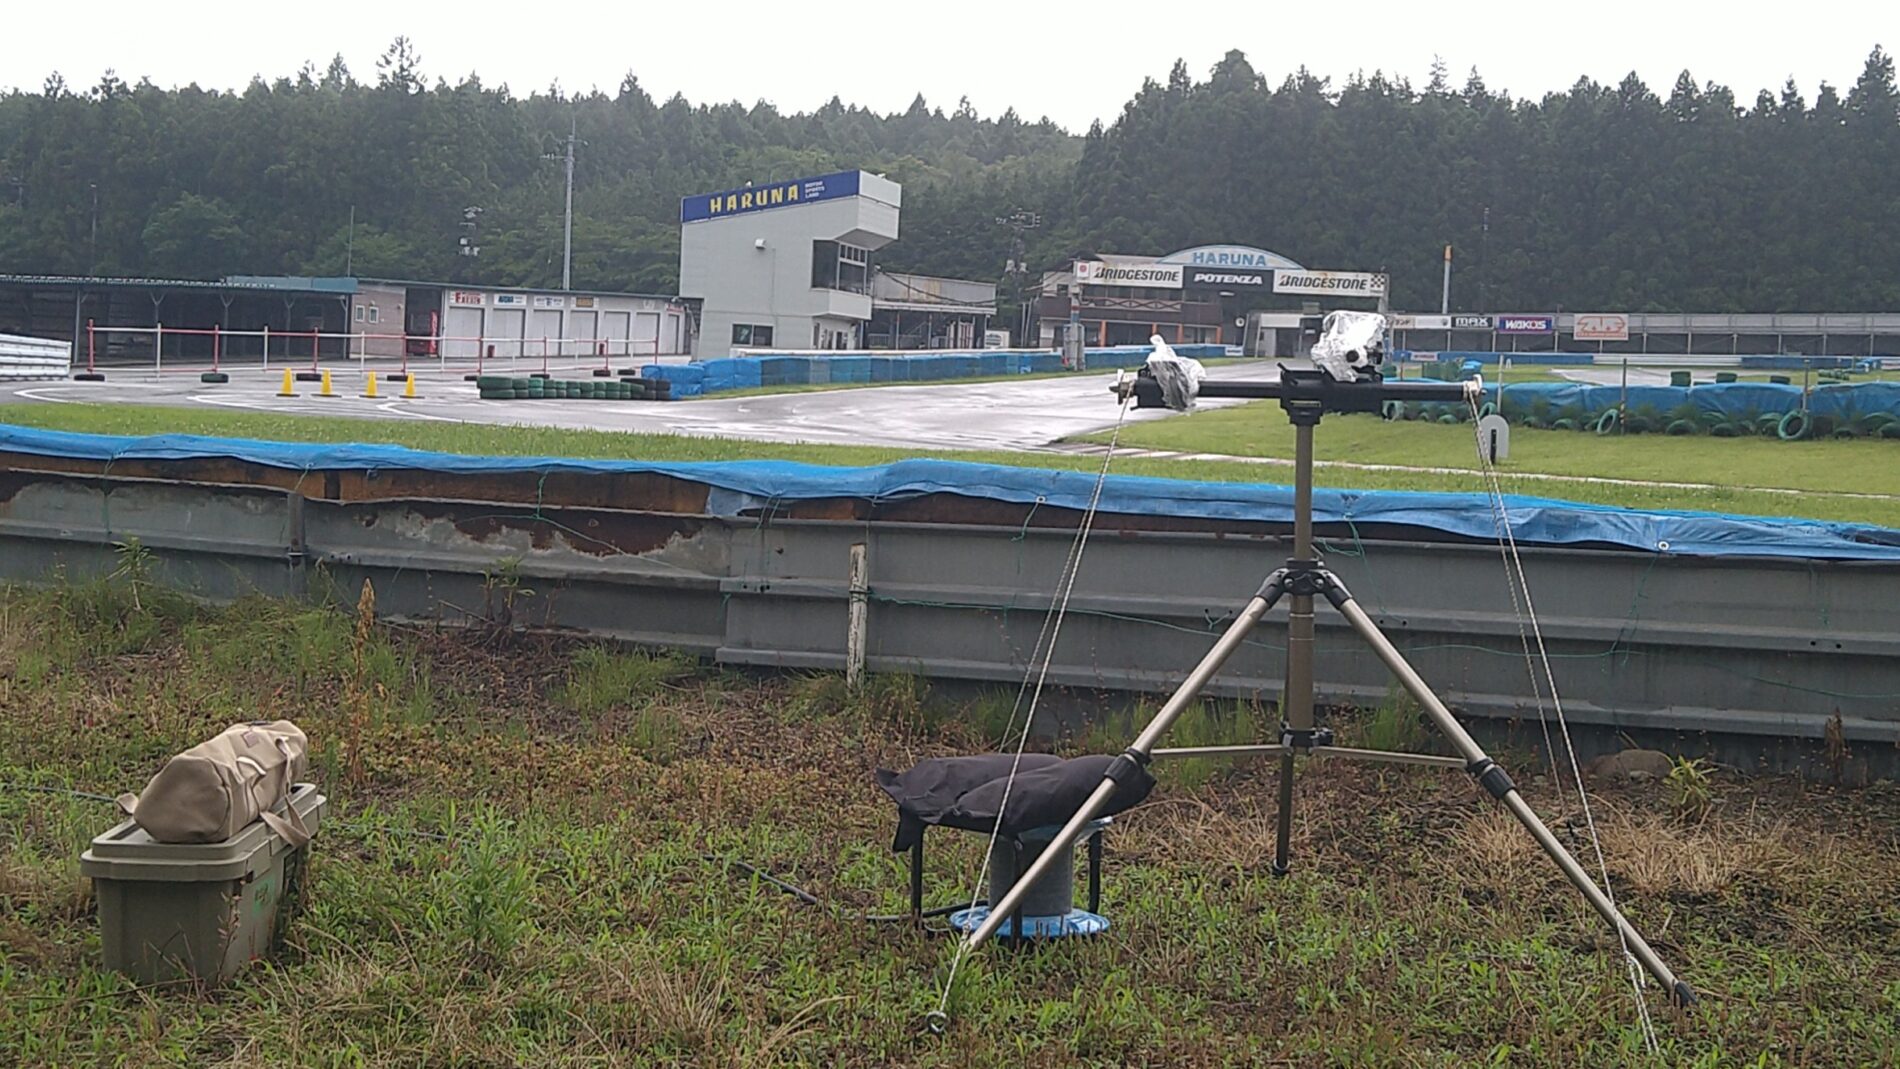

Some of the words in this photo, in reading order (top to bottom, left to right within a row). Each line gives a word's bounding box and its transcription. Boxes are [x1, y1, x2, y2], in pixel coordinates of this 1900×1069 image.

[710, 184, 798, 213] HARUNA
[1193, 252, 1266, 266] HARUNA
[1094, 267, 1180, 282] BRIDGESTONE
[1193, 273, 1263, 285] POTENZA
[1278, 274, 1368, 290] BRIDGESTONE
